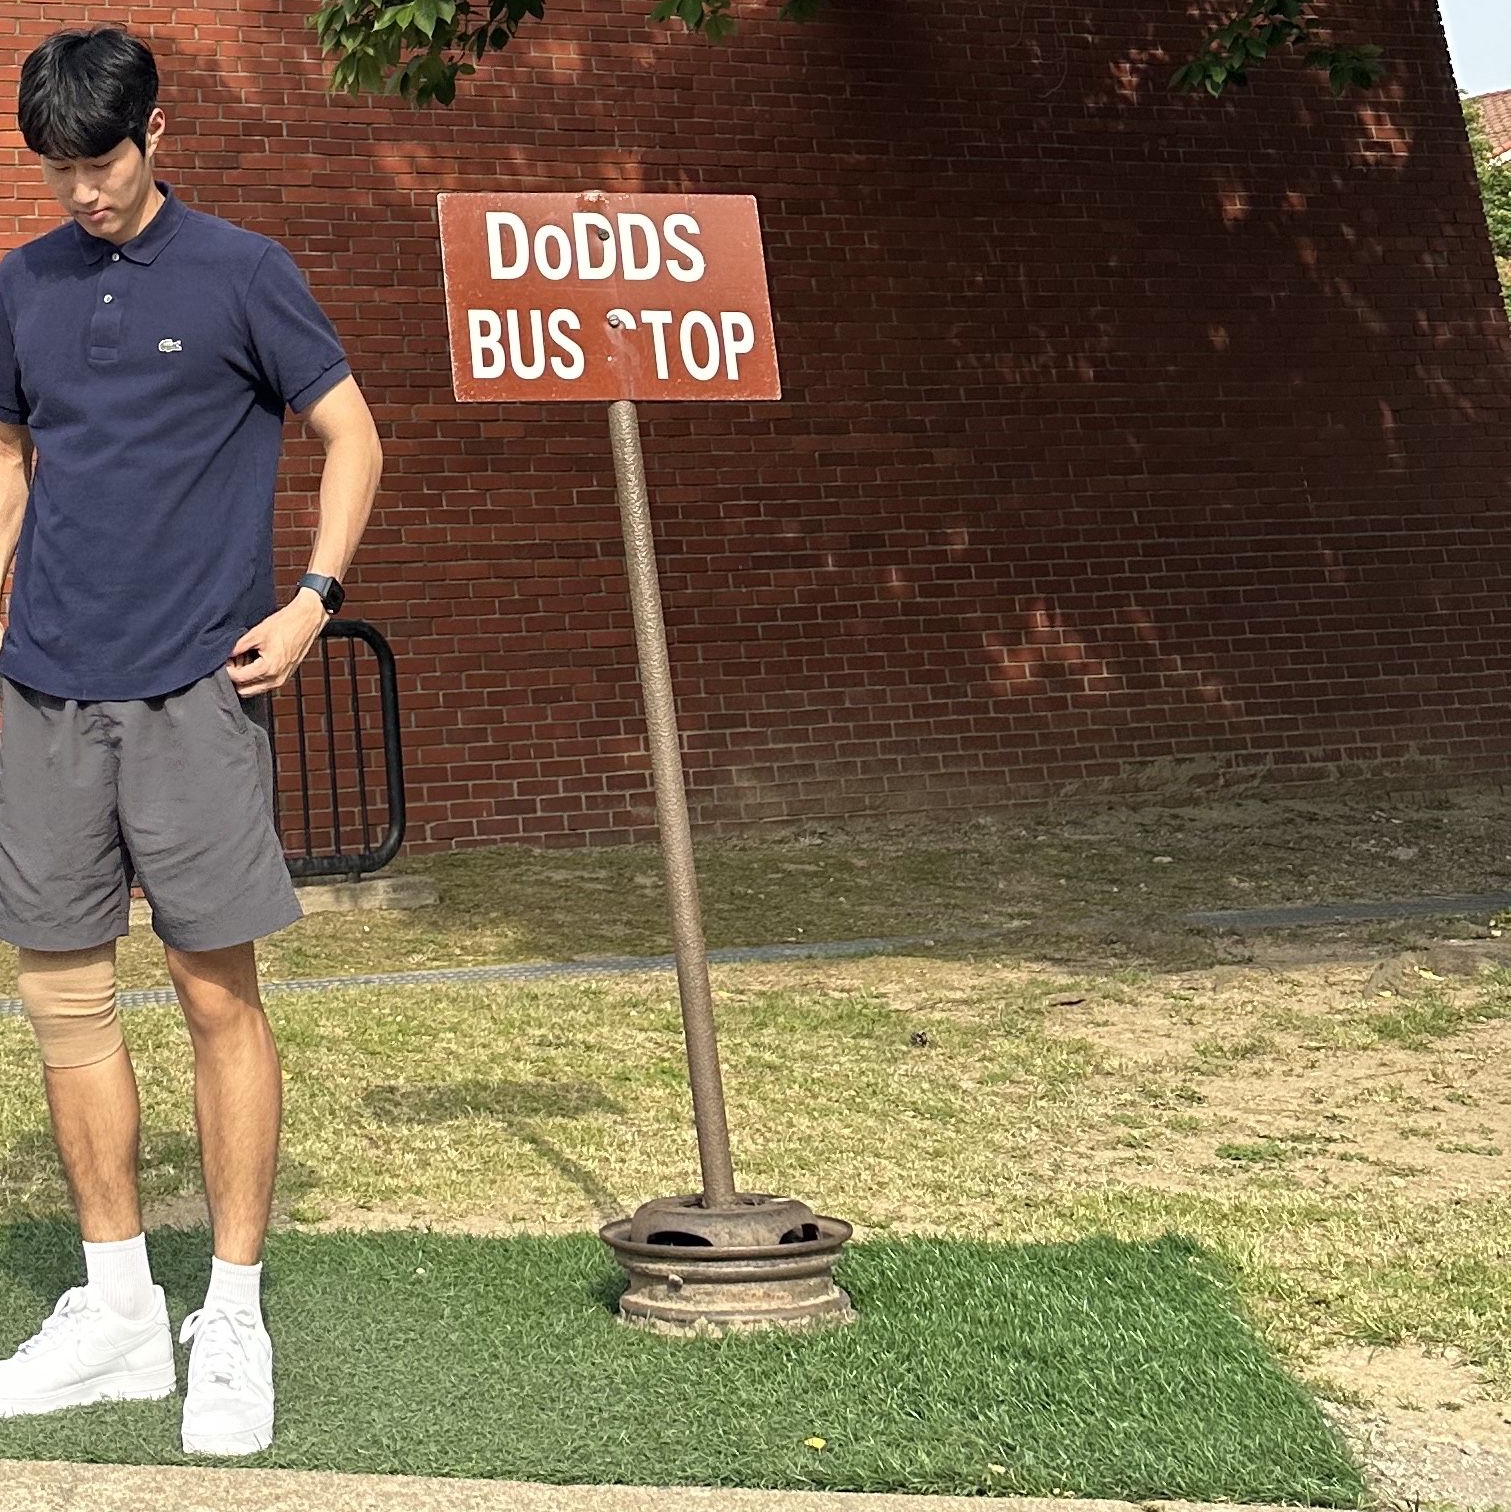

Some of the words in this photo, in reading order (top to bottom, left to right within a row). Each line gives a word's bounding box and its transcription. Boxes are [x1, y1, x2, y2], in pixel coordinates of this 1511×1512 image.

[485, 211, 706, 283] DoDDS
[467, 308, 586, 380] BUS
[605, 308, 755, 381] TOP
